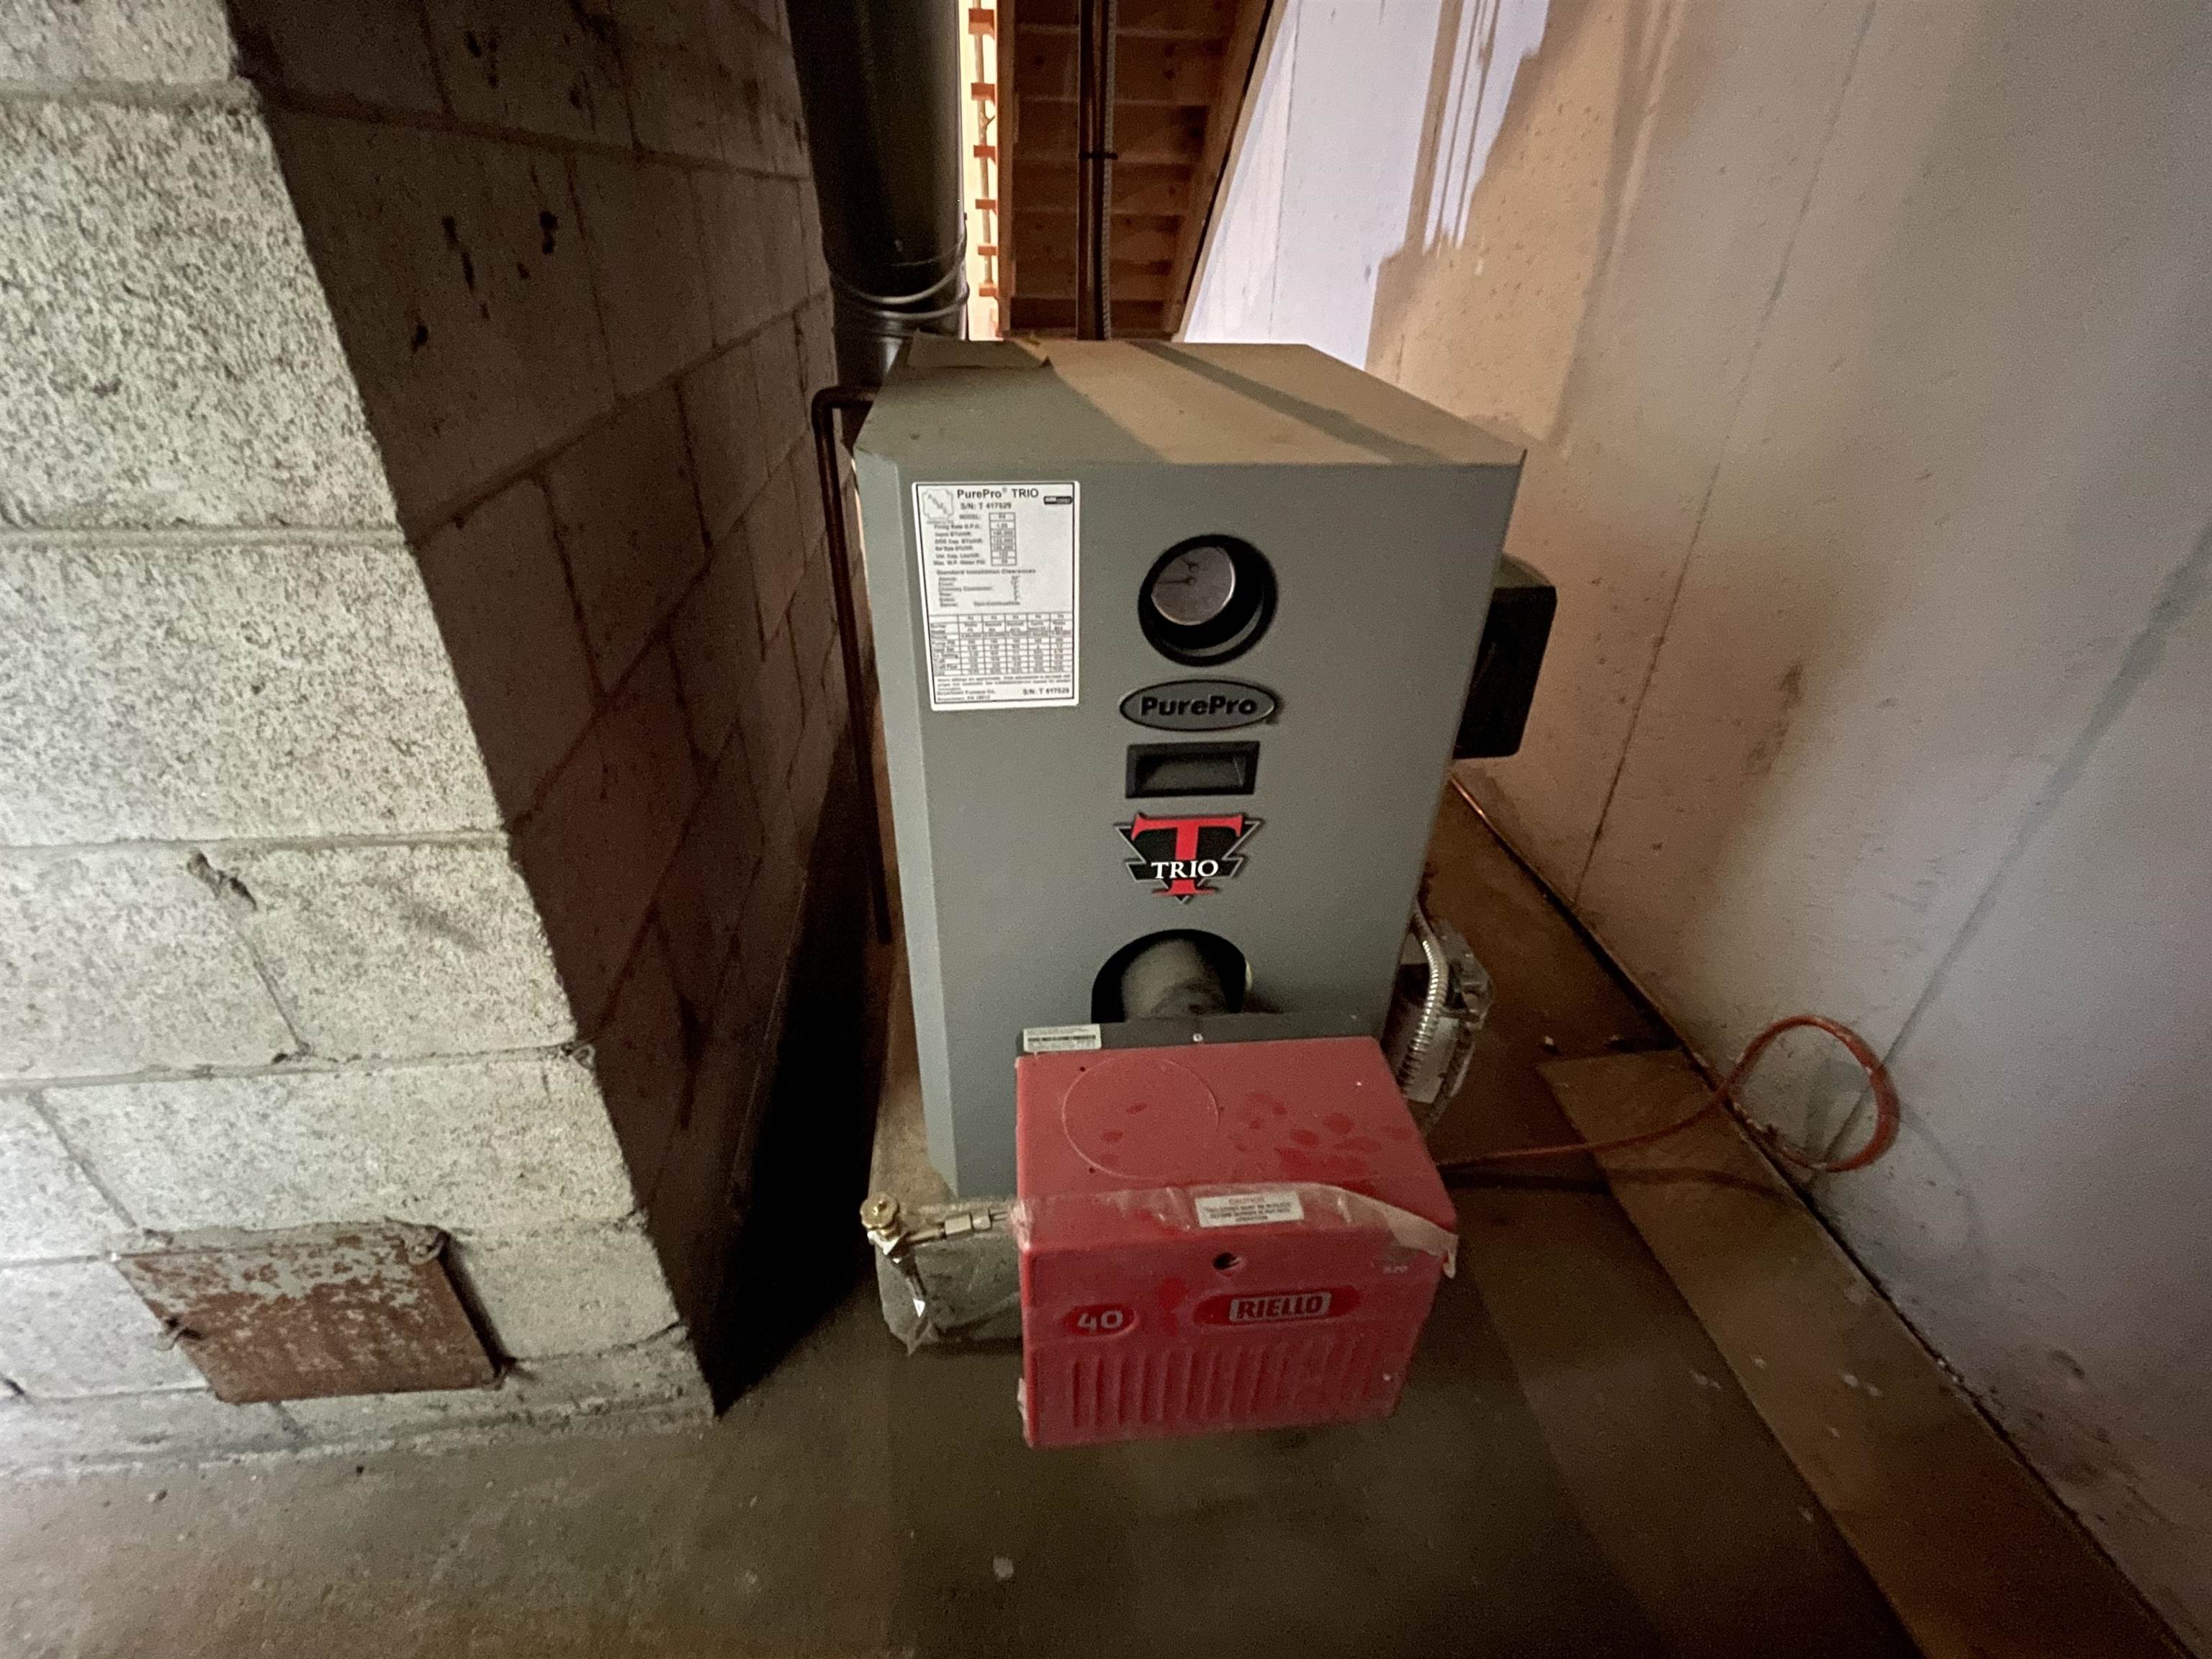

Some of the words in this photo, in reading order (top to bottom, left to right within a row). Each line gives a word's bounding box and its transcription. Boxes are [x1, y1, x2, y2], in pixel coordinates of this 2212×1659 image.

[1012, 488, 1039, 498] TRIO
[1141, 695, 1258, 716] PurePro
[1151, 860, 1218, 878] TRIO
[1236, 1295, 1323, 1320] RIELLO
[1077, 1309, 1124, 1332] 40
